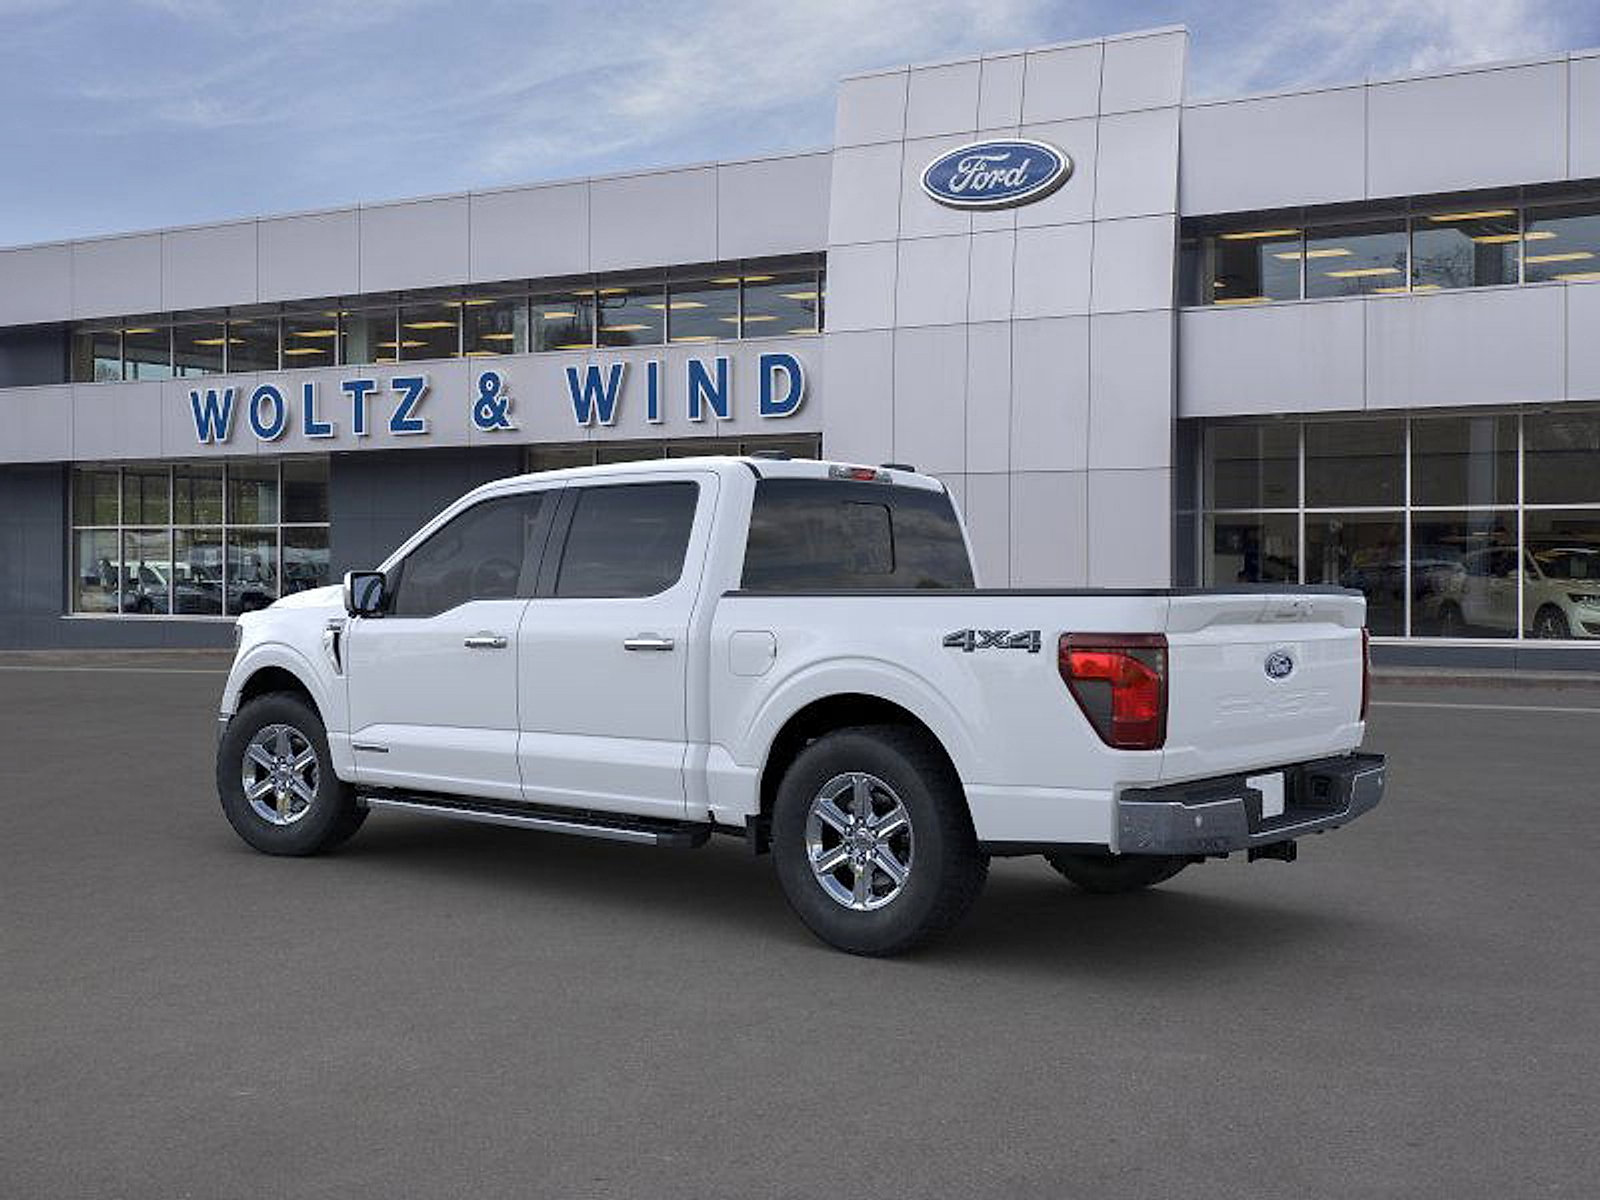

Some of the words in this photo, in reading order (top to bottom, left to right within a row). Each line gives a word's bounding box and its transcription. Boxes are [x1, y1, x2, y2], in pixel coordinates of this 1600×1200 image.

[949, 152, 1031, 193] Ford
[190, 376, 429, 443] WOLTZ
[472, 371, 514, 430] &
[566, 352, 806, 426] WIND
